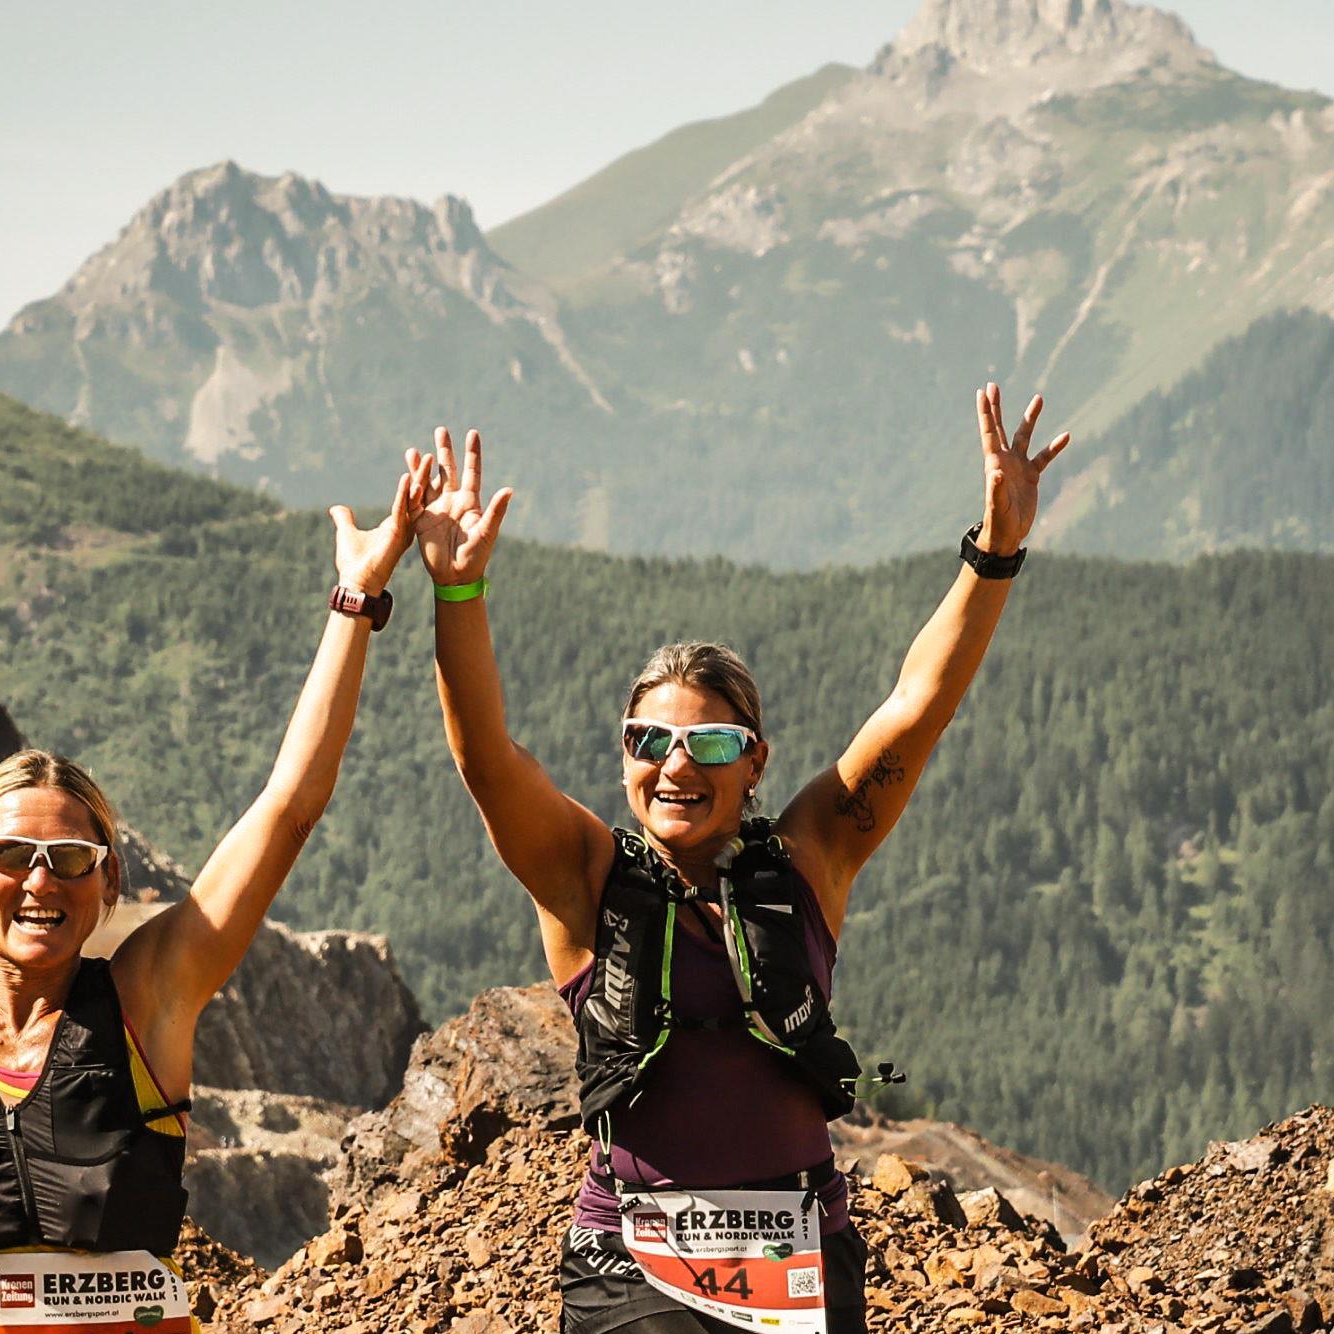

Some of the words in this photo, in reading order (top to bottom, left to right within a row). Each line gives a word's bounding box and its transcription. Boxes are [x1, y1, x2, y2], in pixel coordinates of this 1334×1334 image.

[676, 1209, 795, 1231] ERZBERG
[676, 1232, 701, 1242] RUN
[704, 1232, 712, 1241] &
[715, 1231, 760, 1241] NORDIC
[761, 1230, 795, 1241] WALK
[0, 1279, 33, 1291] Kronen
[43, 1268, 166, 1295] ERZBERG
[1, 1291, 34, 1304] Zeitung
[44, 1295, 70, 1306] RUN
[73, 1295, 83, 1305] &
[85, 1293, 131, 1305] NORDIC
[132, 1291, 166, 1302] WALK
